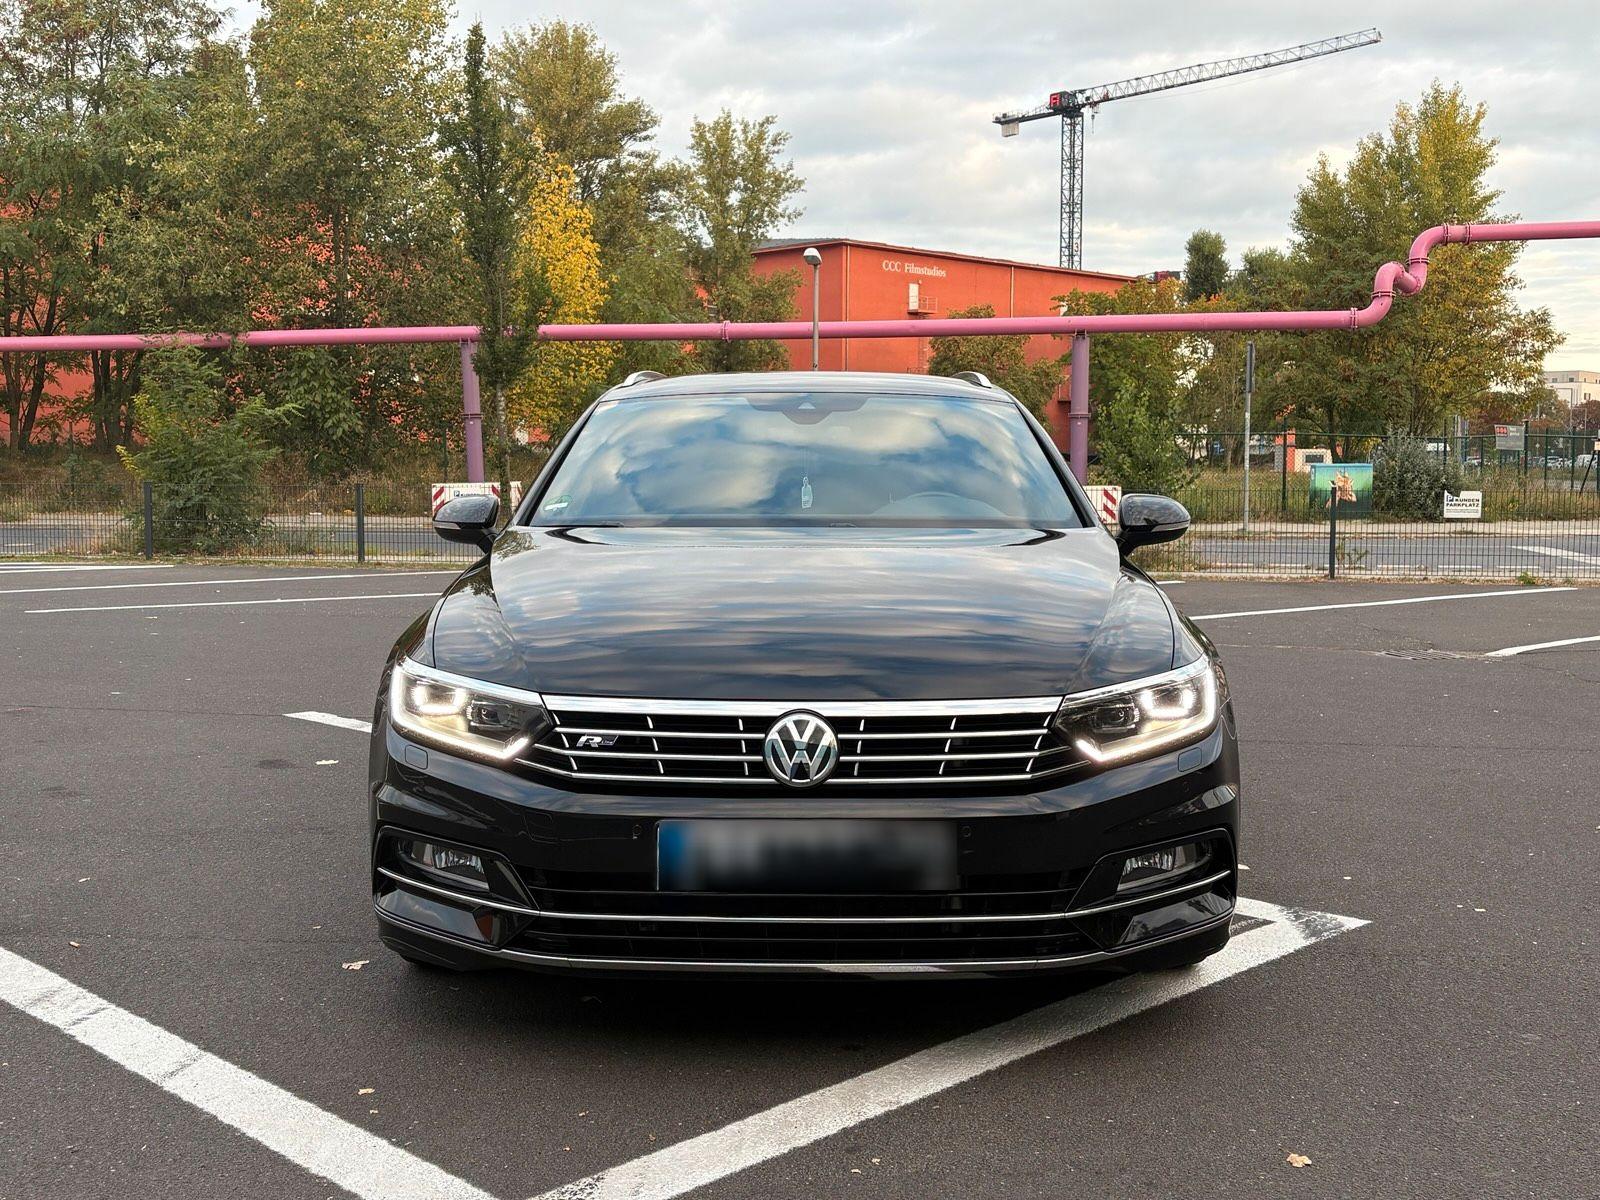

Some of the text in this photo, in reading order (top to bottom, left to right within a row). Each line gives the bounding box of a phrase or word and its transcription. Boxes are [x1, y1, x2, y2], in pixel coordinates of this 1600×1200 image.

[1074, 242, 1079, 253] 3
[882, 260, 947, 277] CCC Filmstudios
